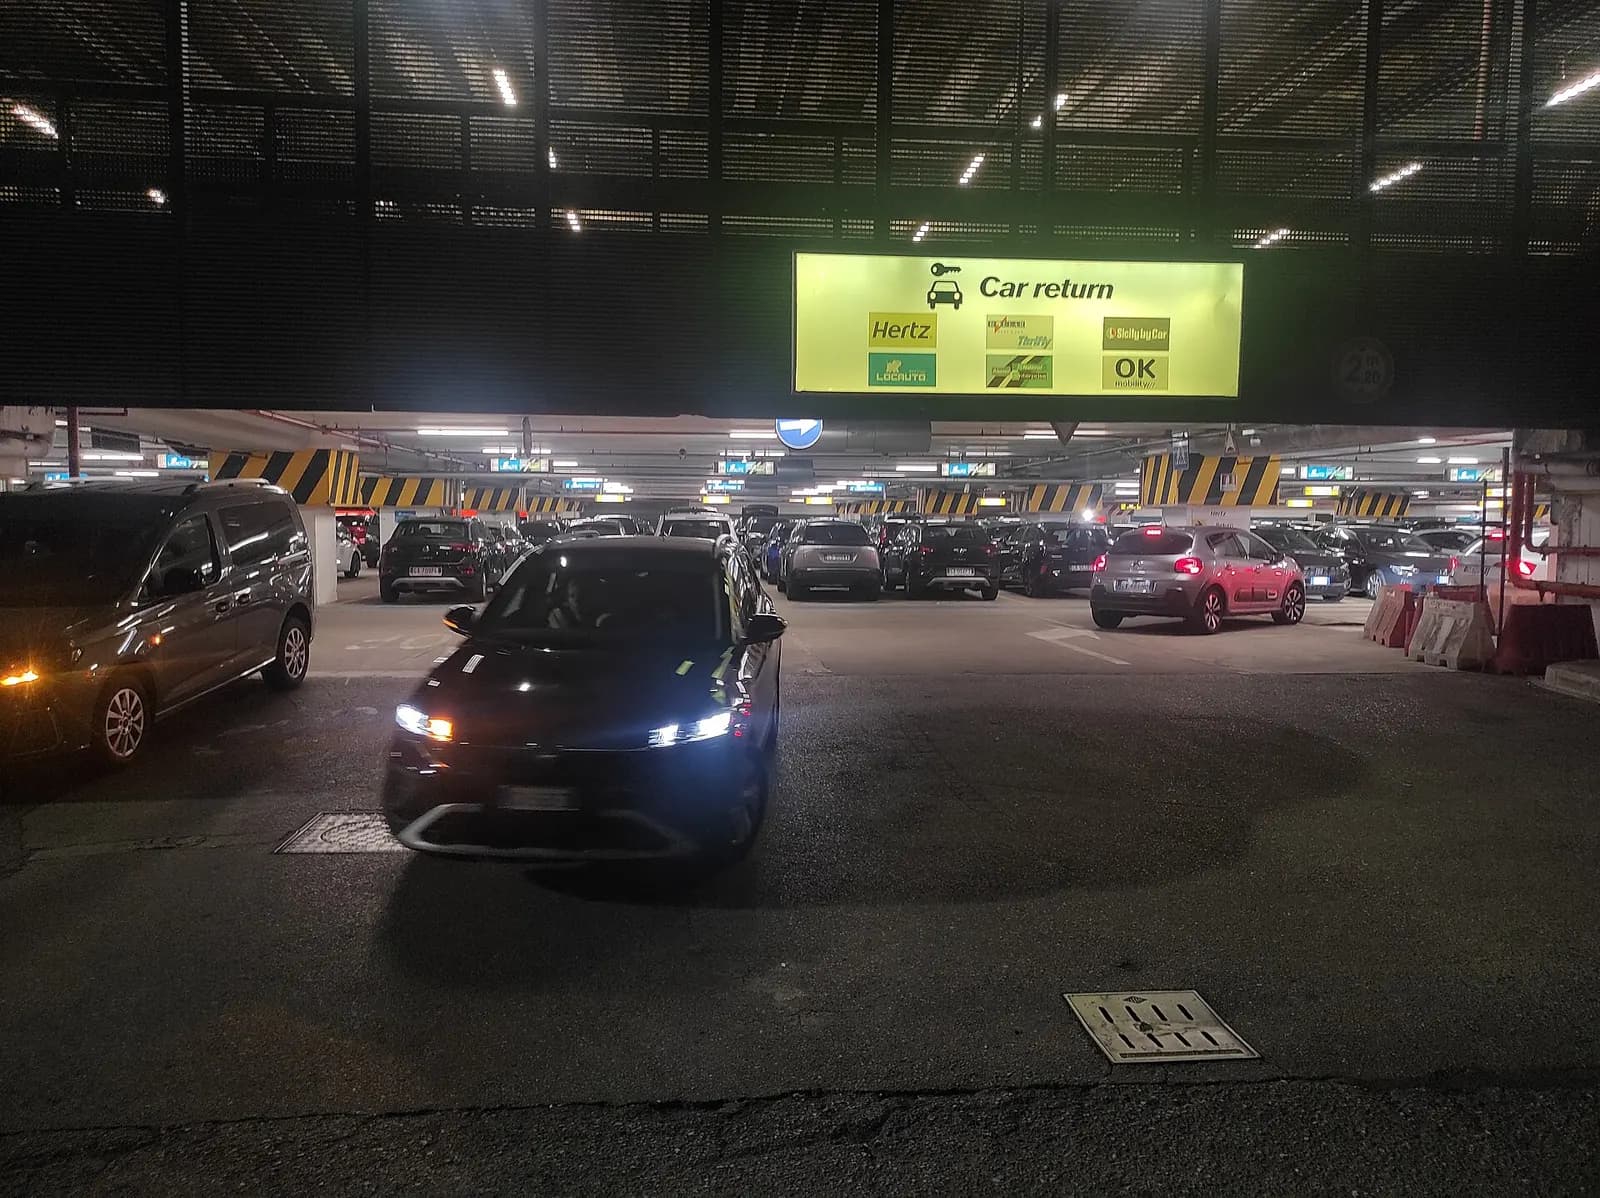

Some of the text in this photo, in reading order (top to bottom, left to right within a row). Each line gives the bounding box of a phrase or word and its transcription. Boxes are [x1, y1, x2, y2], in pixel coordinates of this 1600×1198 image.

[980, 276, 1114, 299] Car return
[873, 321, 931, 339] Hertz
[1018, 335, 1052, 349] Thrifty
[1115, 358, 1156, 379] OK
